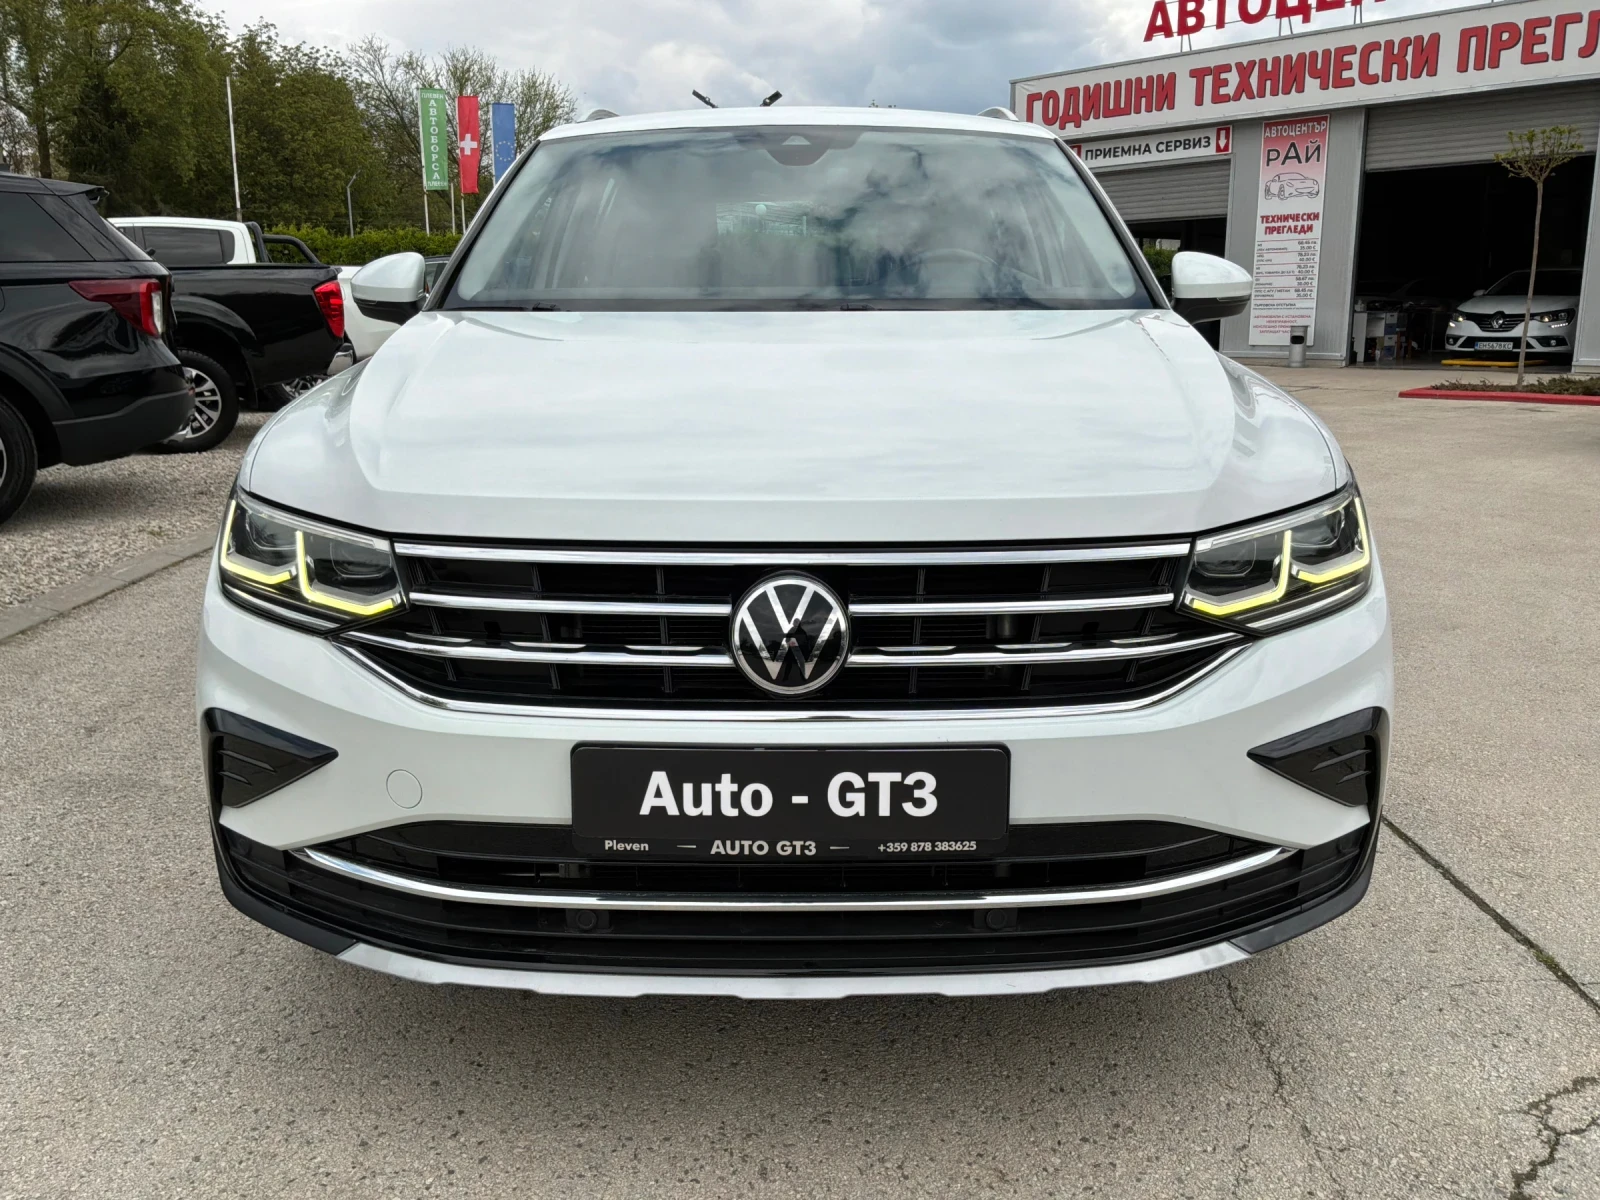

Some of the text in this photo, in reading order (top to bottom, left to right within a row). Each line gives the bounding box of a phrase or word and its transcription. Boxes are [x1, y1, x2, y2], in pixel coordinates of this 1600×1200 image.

[1026, 71, 1176, 130] ГОДИШНИ
[1189, 32, 1441, 106] ТЕХНИЧЕСКИ
[428, 100, 440, 180] АВТОБОРСА
[1264, 121, 1327, 138] АВТОЦЕНТЪР
[1084, 135, 1211, 161] ПРИЕМНА СЕРВИЗ
[1266, 140, 1321, 167] РАЙ
[1260, 212, 1320, 225] ТЕХНИЧЕСКИ
[1264, 224, 1314, 236] ПРЕГЛЕДИ
[639, 770, 773, 817] Auto
[827, 770, 938, 818] GT3
[604, 839, 977, 856] Pleven AUTO GT3 +359 878 383625
